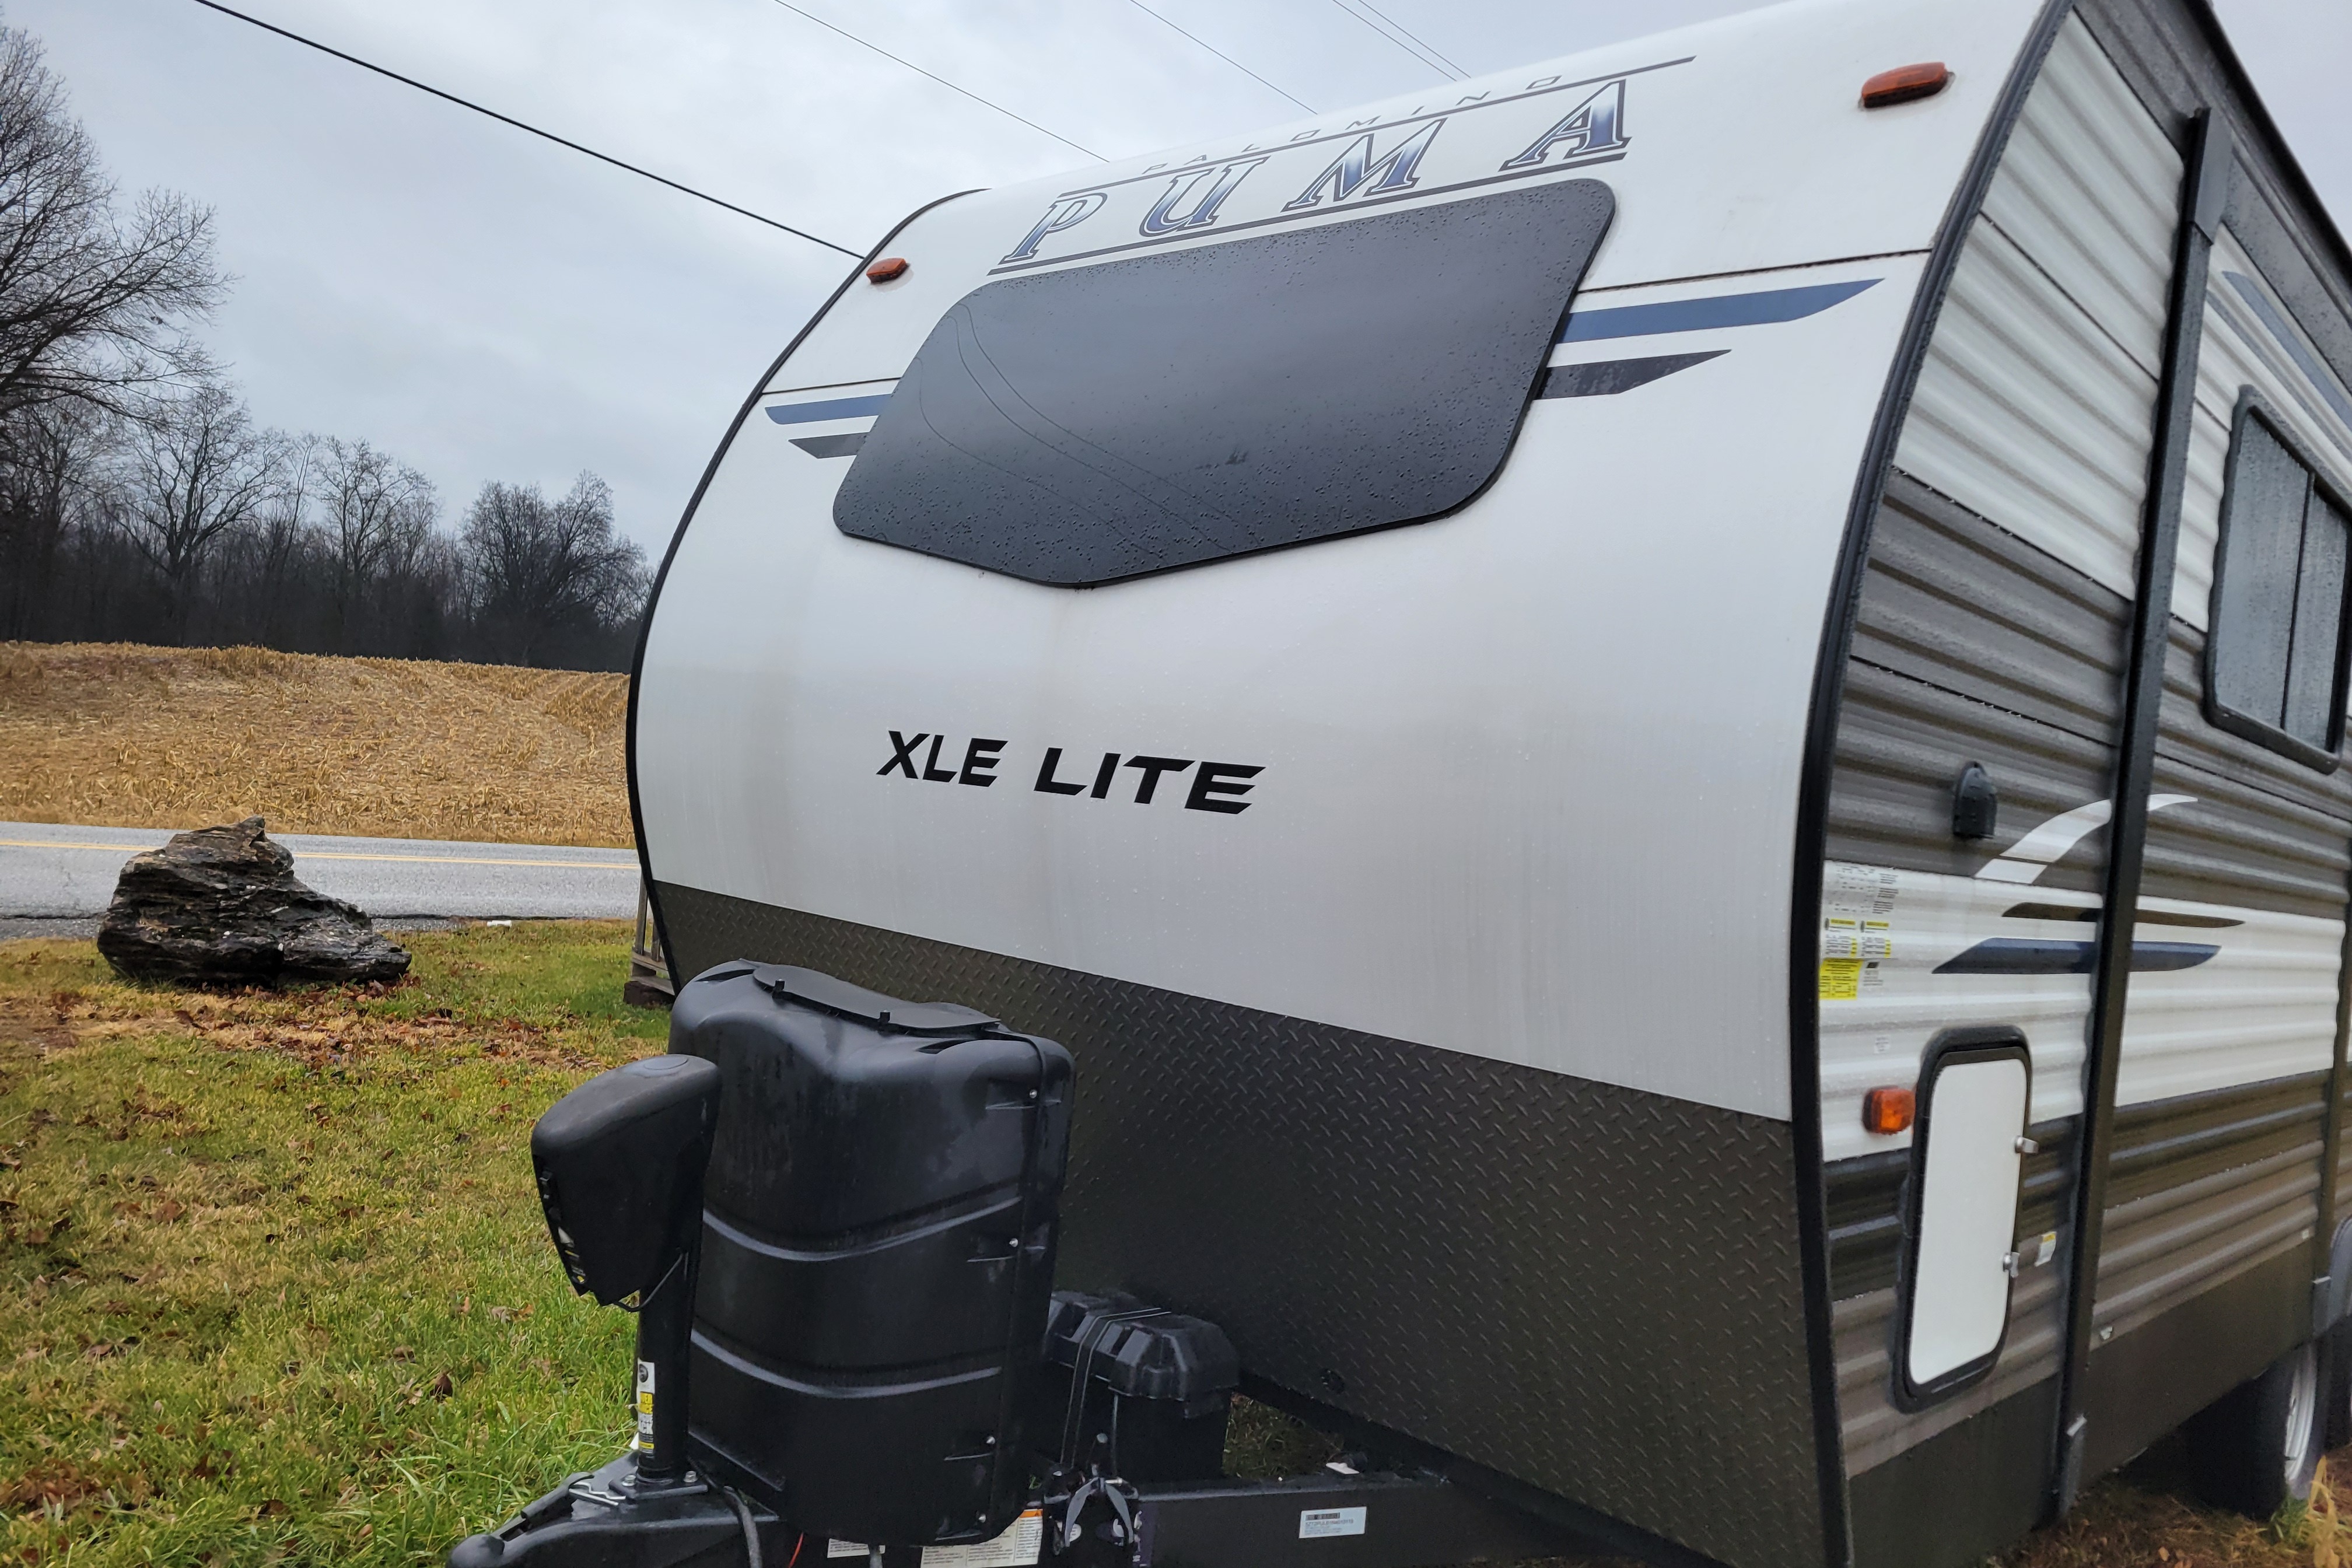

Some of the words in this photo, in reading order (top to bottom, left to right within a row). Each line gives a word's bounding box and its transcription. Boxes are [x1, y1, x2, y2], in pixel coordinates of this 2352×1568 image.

[998, 79, 1632, 265] PUMA
[1142, 75, 1562, 175] PALOMINO
[876, 730, 1009, 788] XLE
[1033, 747, 1266, 815] LITE
